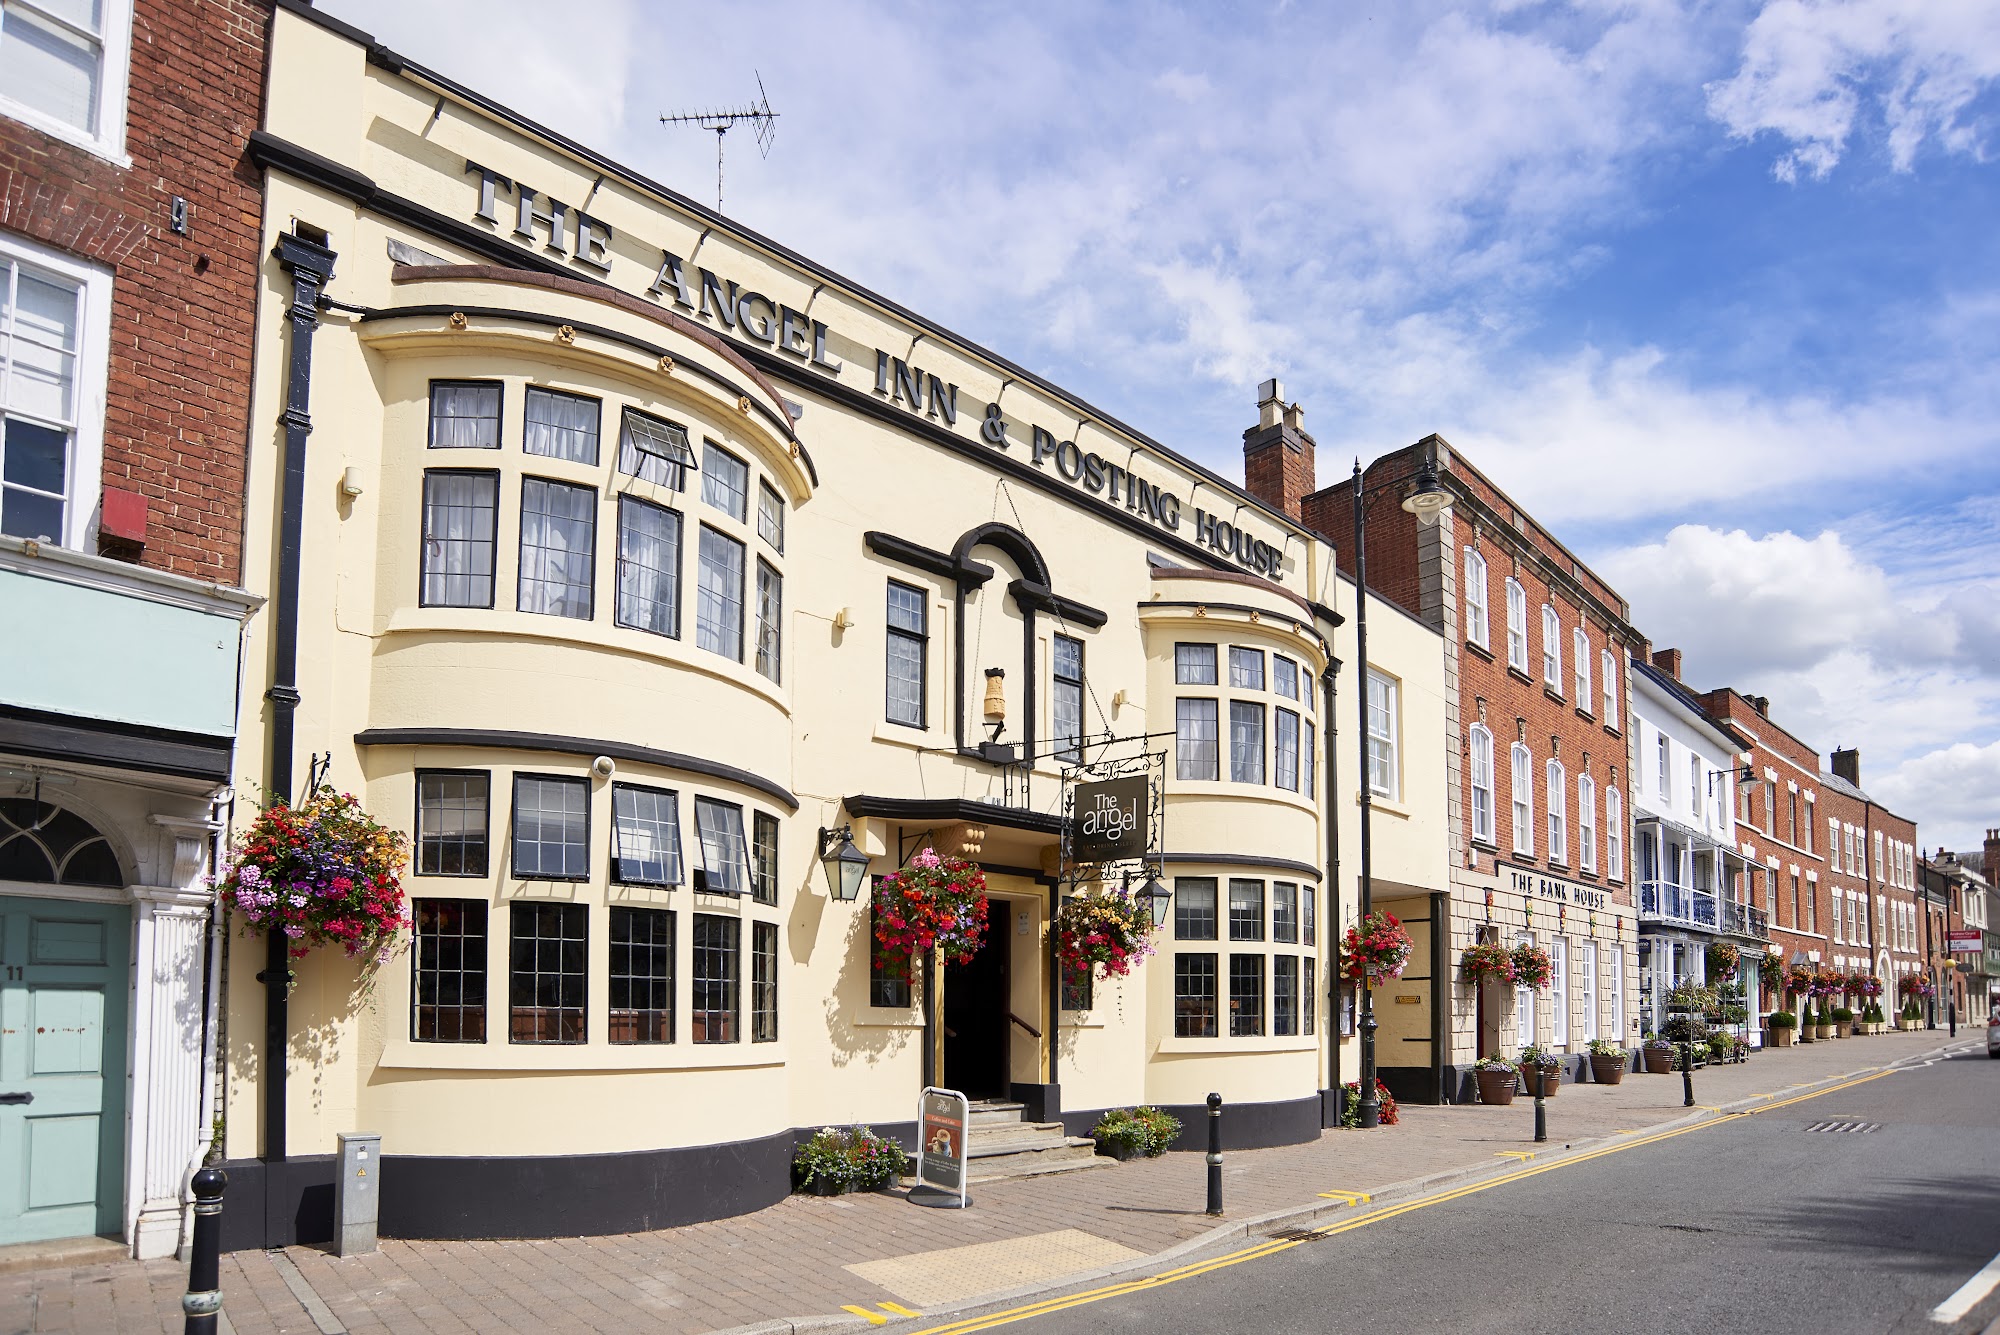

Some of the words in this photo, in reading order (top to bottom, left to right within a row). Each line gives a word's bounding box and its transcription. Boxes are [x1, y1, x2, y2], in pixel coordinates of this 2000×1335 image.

[464, 158, 613, 273] THE
[648, 249, 842, 374] ANGEL
[873, 348, 960, 425] INN
[982, 402, 1010, 448] &
[1031, 423, 1181, 531] POSTING
[1195, 507, 1284, 581] HOUSE
[1083, 797, 1137, 840] angel
[1094, 793, 1117, 809] The
[1511, 872, 1533, 893] THE
[1540, 879, 1567, 901] BANK
[1574, 887, 1605, 910] HOUSE
[6, 965, 24, 981] 11
